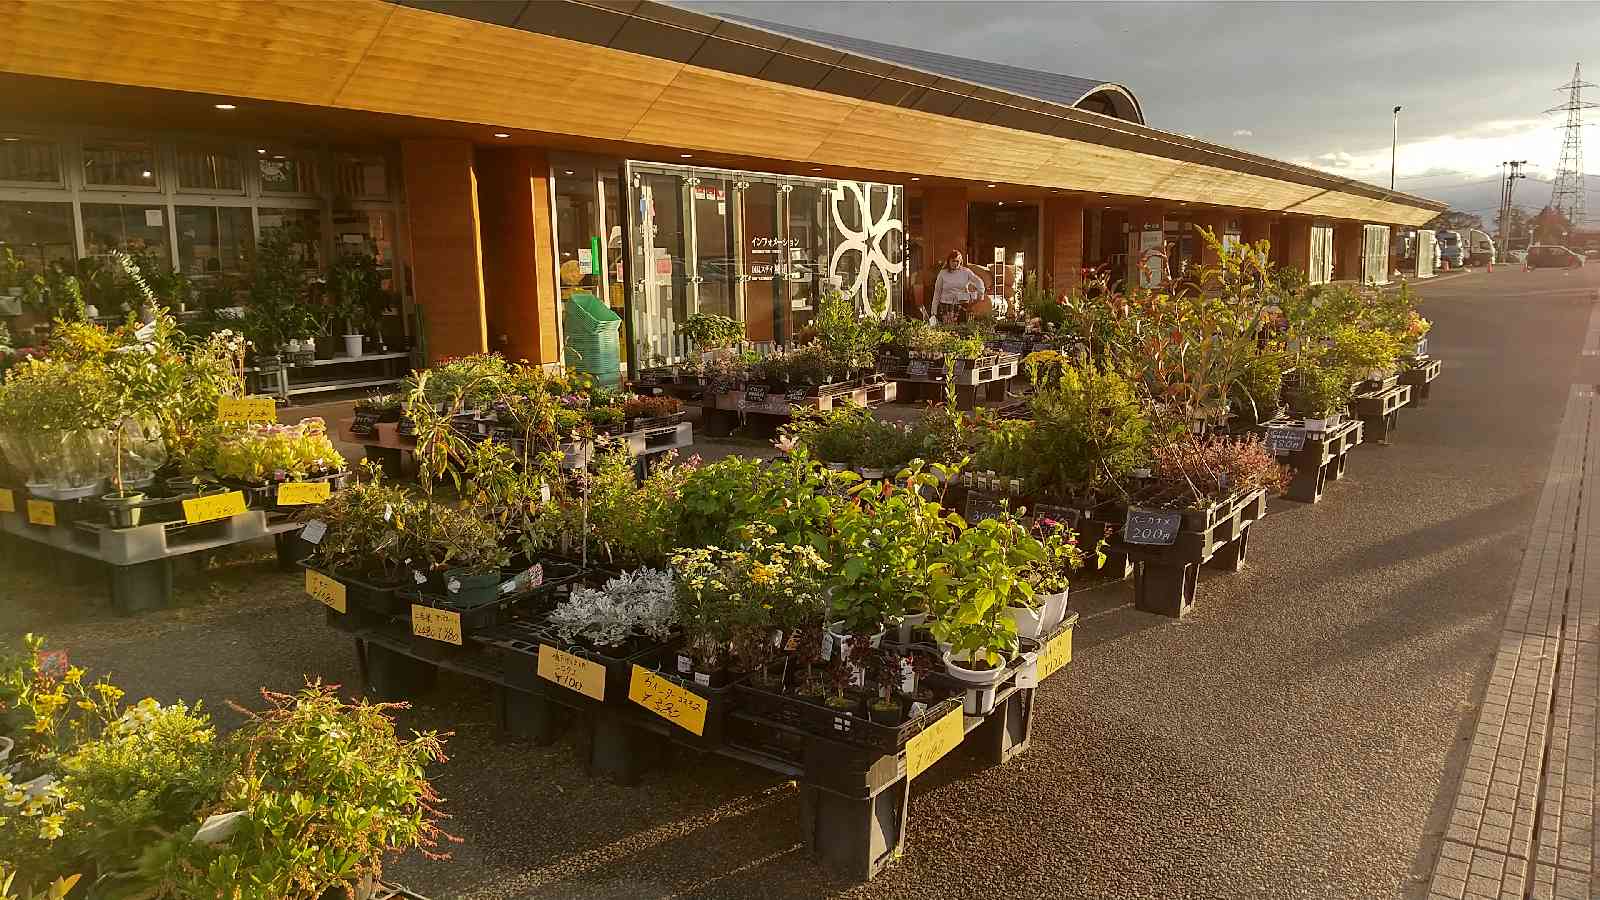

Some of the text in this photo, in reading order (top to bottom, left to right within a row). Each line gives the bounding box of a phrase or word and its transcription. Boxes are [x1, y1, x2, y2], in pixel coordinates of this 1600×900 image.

[752, 236, 800, 248] インフォメーション
